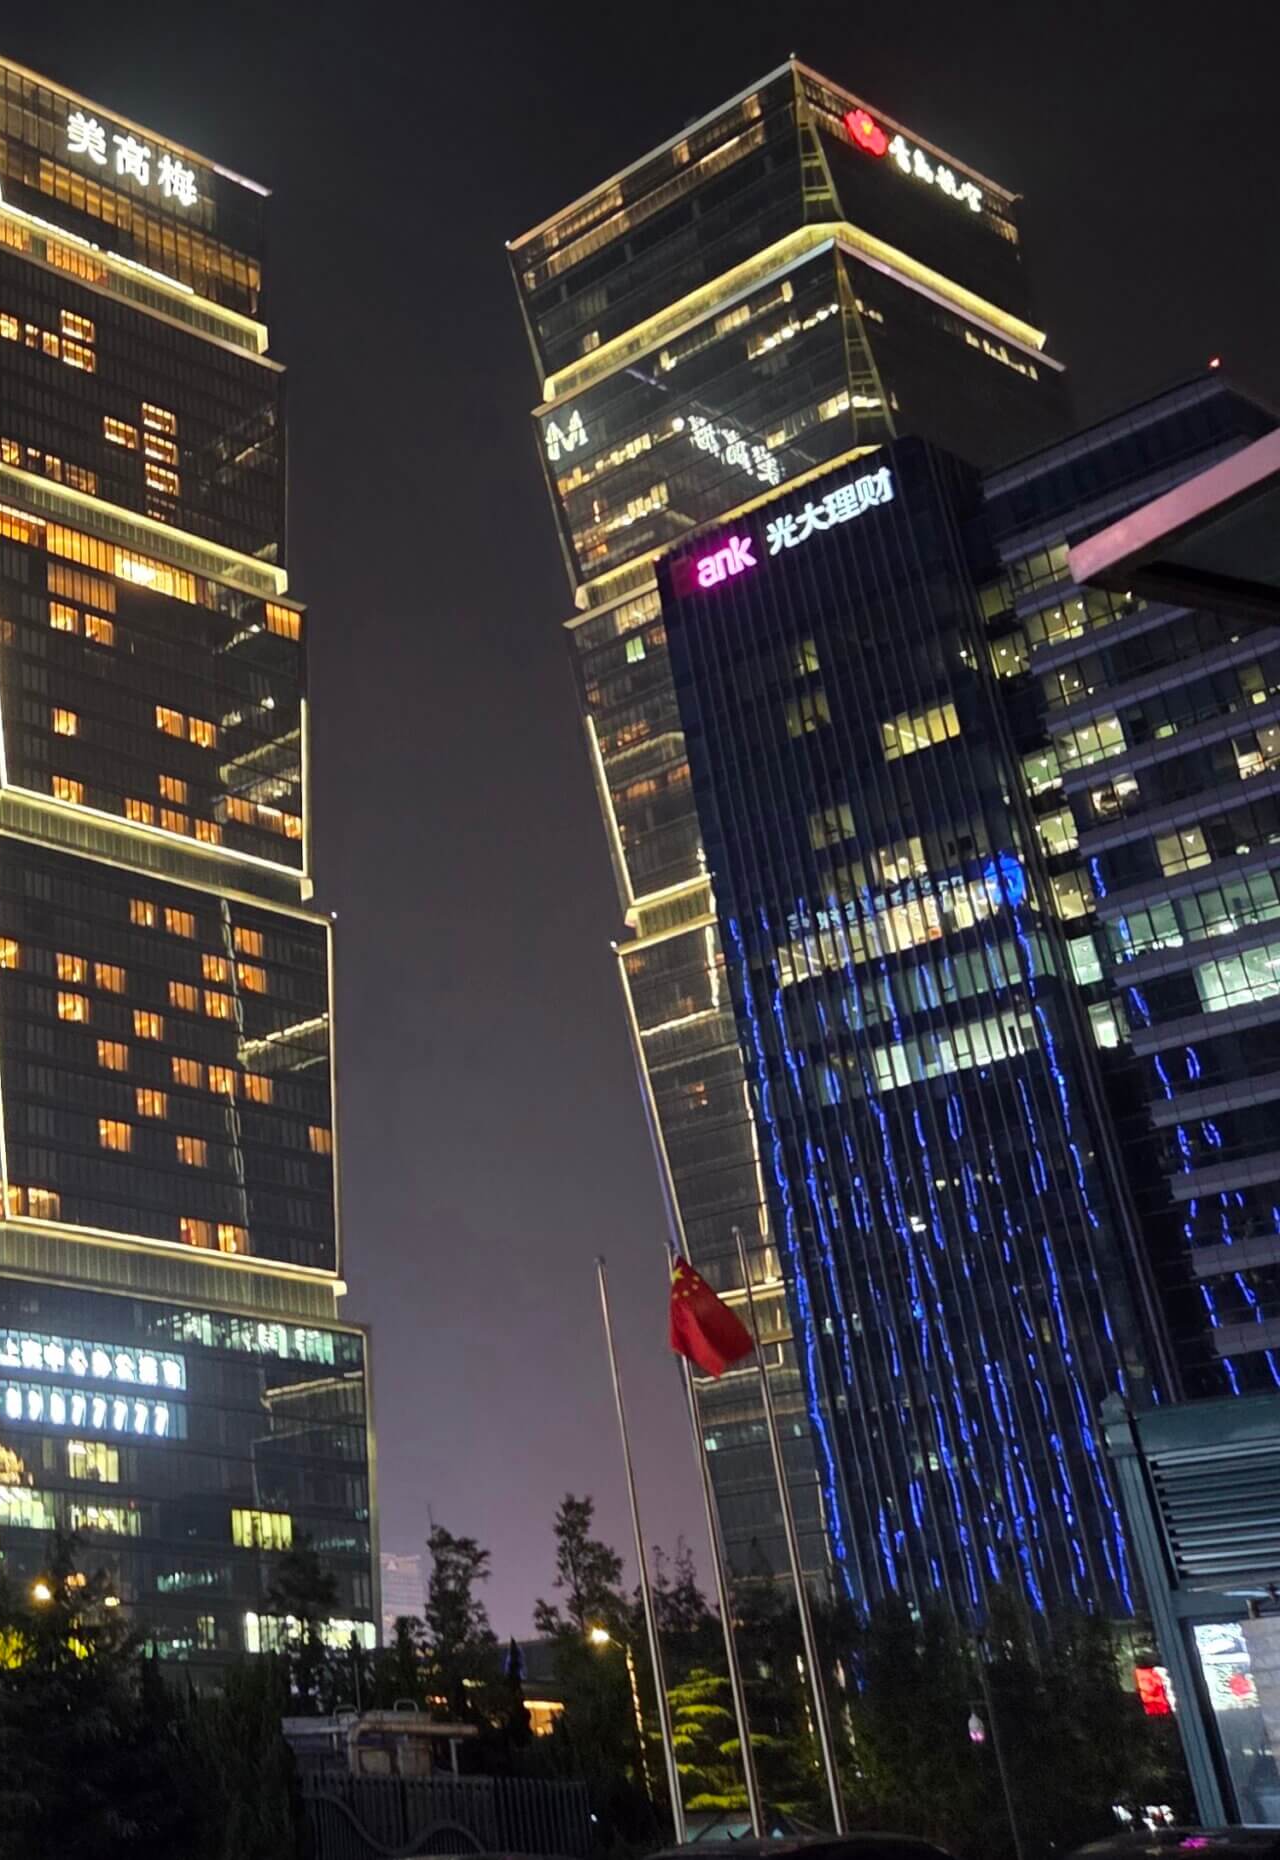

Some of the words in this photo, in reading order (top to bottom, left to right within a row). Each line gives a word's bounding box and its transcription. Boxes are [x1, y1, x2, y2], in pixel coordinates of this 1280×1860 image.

[67, 112, 199, 207] 美高梅
[766, 467, 894, 556] 光大理财
